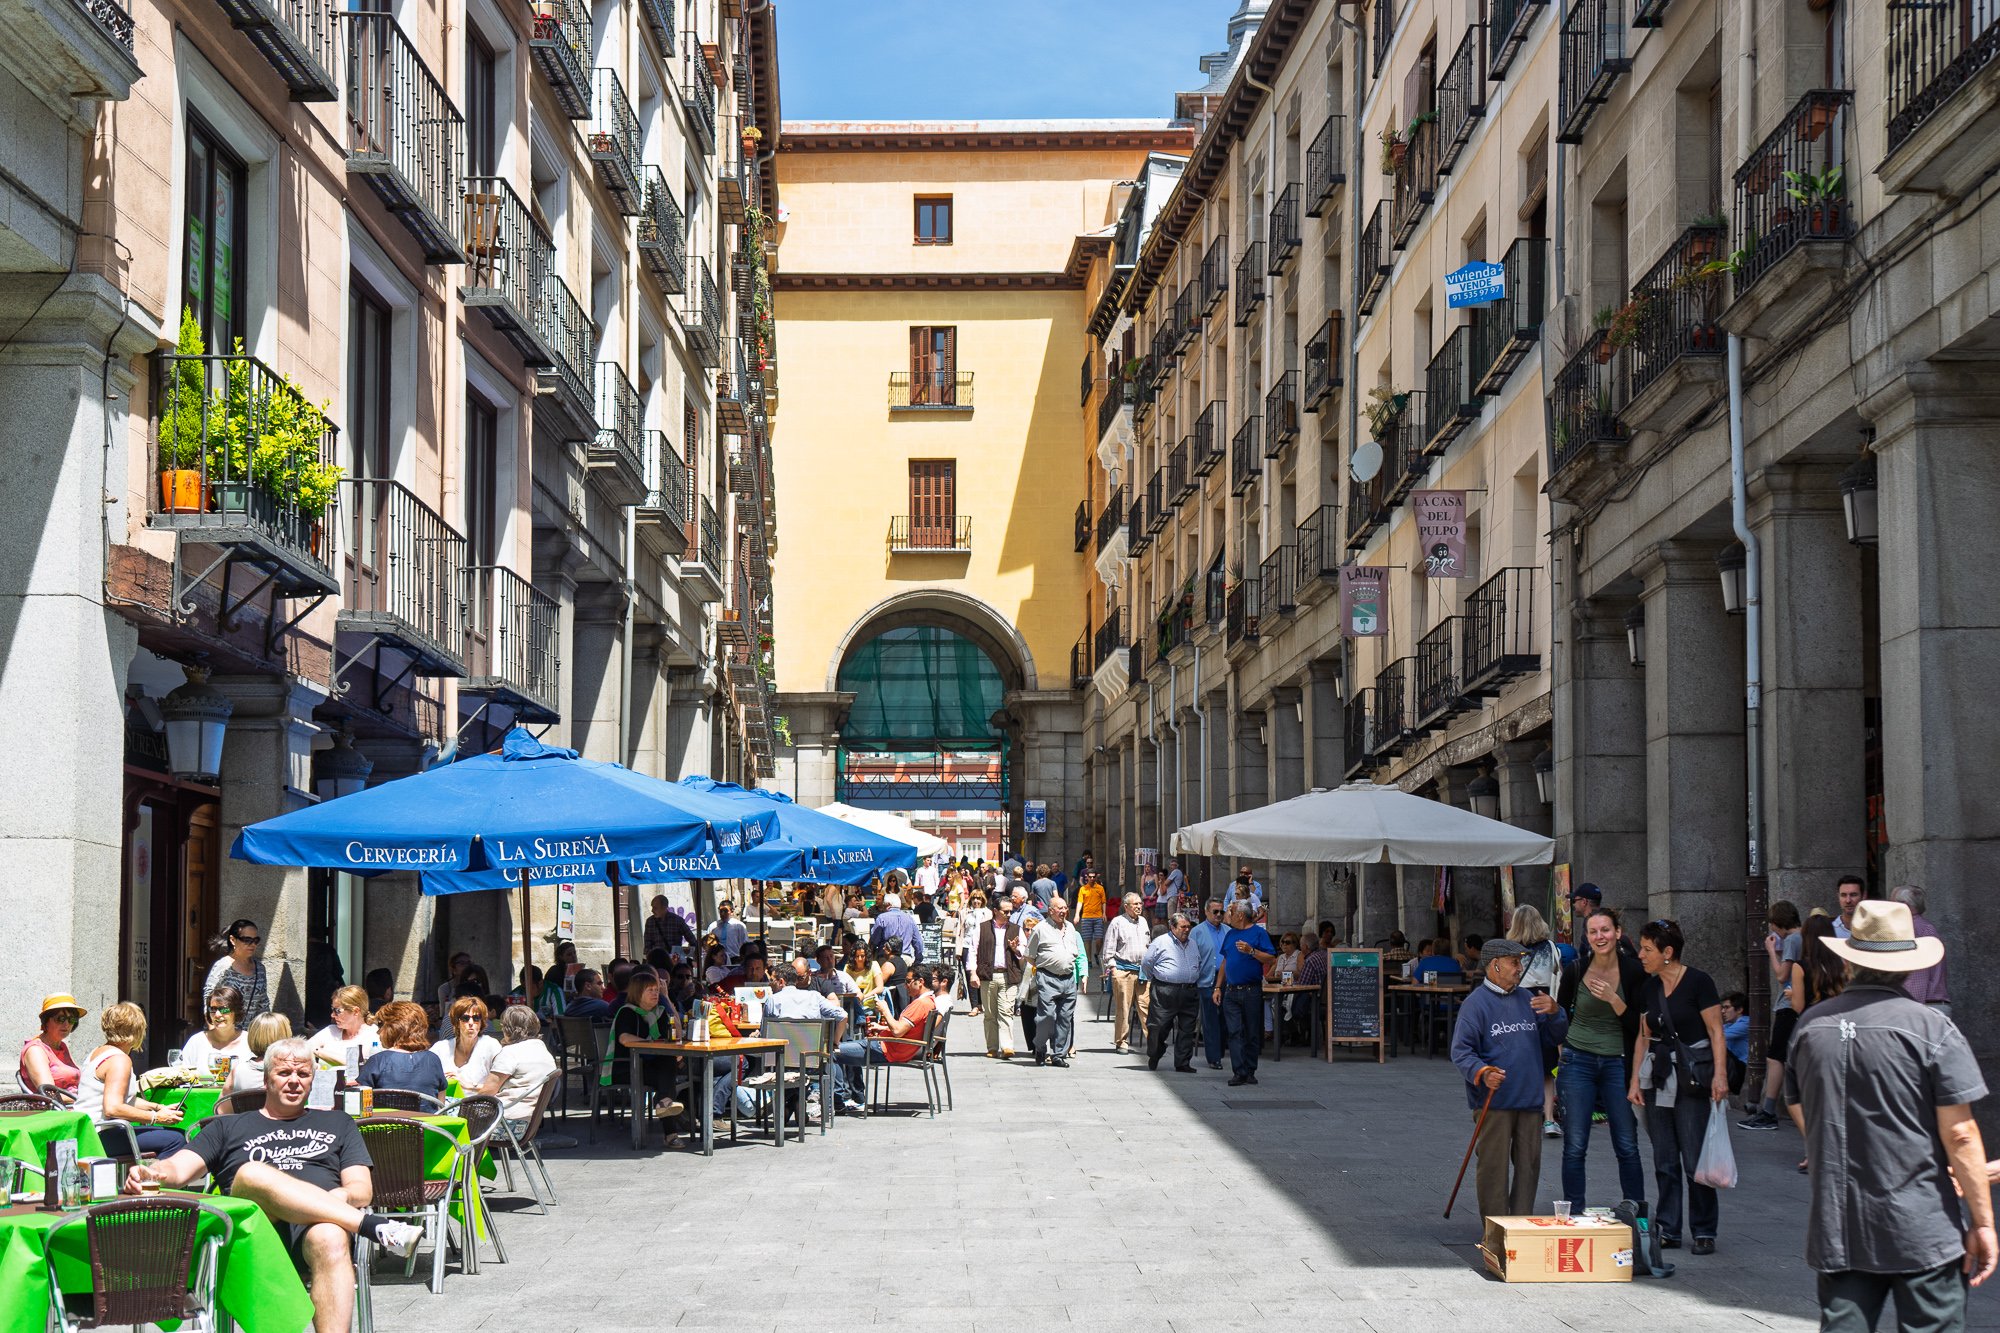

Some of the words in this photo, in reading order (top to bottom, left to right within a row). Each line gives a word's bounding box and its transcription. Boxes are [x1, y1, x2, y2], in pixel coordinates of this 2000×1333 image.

[1460, 278, 1492, 291] VENDE
[1452, 294, 1462, 302] 91
[1463, 290, 1478, 300] 535
[1479, 288, 1489, 297] 97
[1490, 285, 1500, 294] 97
[1414, 497, 1429, 507] LA
[1431, 496, 1463, 507] CASA
[1428, 511, 1452, 521] DEL
[1420, 525, 1459, 536] PULPO
[345, 841, 457, 864] CERVECERÍA
[498, 841, 526, 862] LA
[534, 833, 611, 860] SUREÑA
[823, 850, 837, 865] LA
[838, 847, 874, 864] SUREÑA
[630, 858, 652, 874] LA
[658, 853, 722, 872] SUREÑA
[249, 1140, 329, 1163] Originals
